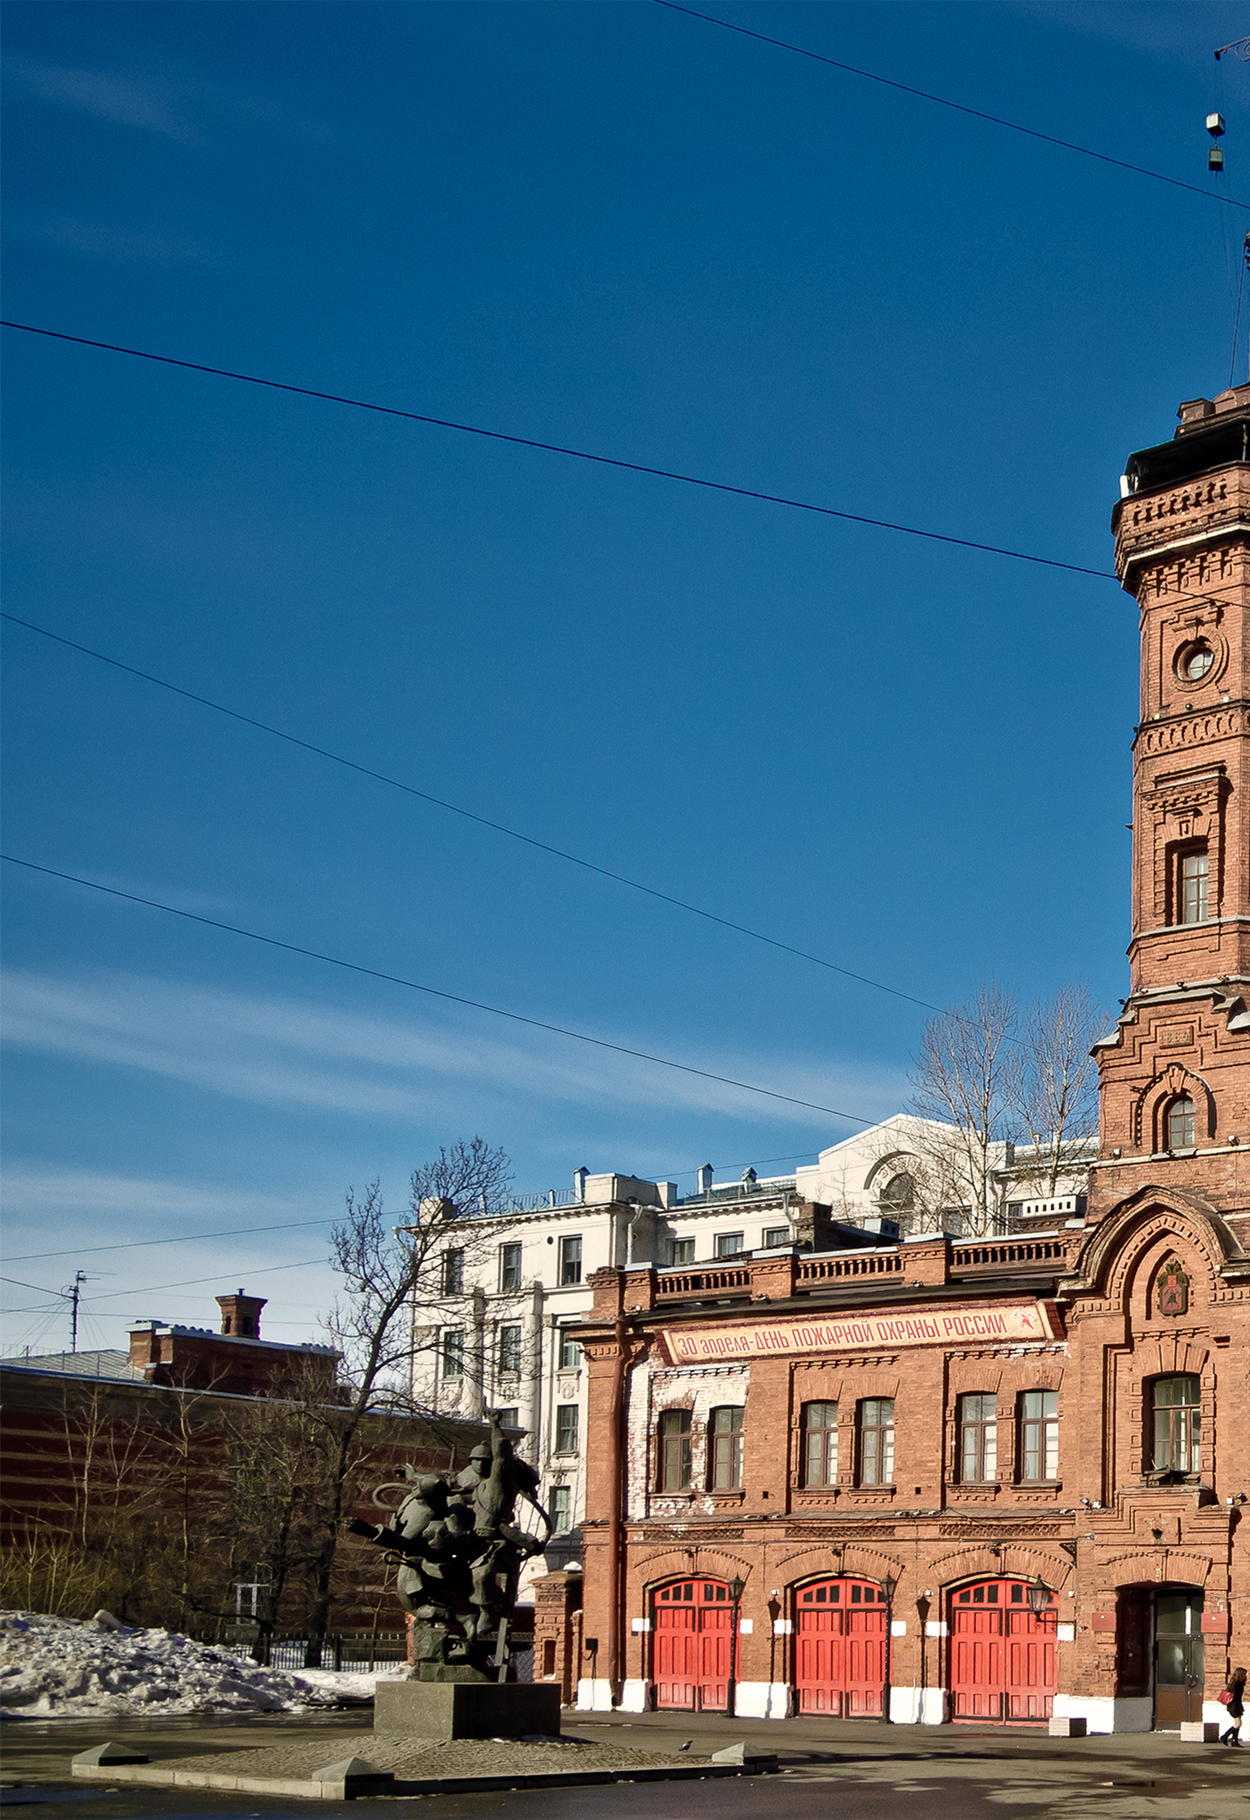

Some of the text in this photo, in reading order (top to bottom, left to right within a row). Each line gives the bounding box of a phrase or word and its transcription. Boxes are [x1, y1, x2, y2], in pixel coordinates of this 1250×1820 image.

[678, 1337, 698, 1356] 30
[792, 1319, 876, 1347] ПОЖАРНОЙ
[877, 1318, 941, 1341] ОХРАНЫ
[943, 1314, 1008, 1337] РОССИИ
